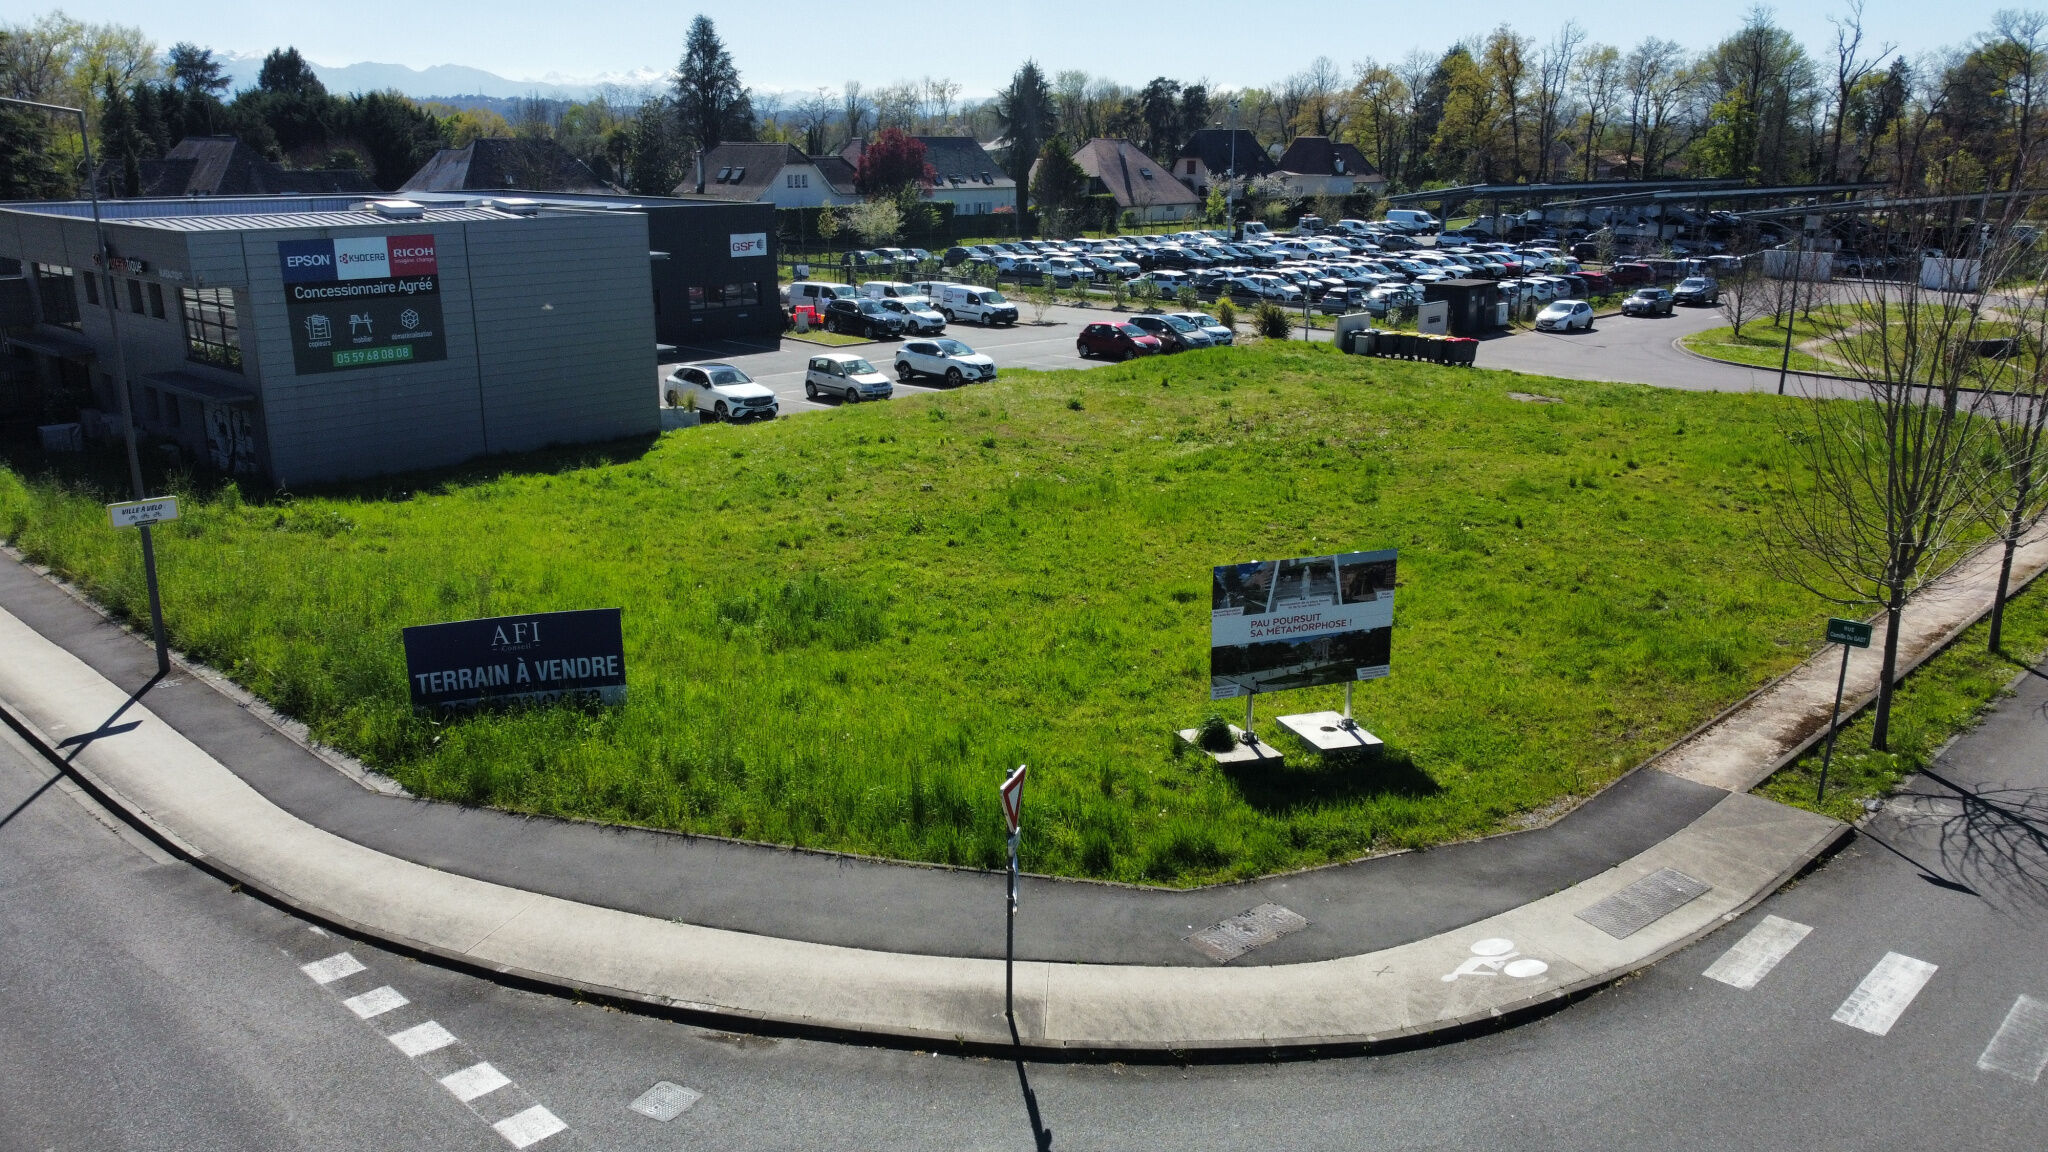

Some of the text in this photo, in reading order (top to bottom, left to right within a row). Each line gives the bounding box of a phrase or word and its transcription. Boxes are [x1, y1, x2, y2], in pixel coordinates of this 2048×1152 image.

[394, 248, 434, 257] RICOH
[732, 241, 755, 252] GSF
[287, 255, 331, 267] EPSON
[294, 277, 433, 300] Concessionnaire Agréé
[337, 348, 409, 364] 05 59 68 08 08
[1250, 613, 1321, 629] PAU POURSUIT
[1250, 629, 1263, 638] SA
[1266, 619, 1347, 636] MÉTAMORPHOSE
[491, 621, 542, 646] AFI
[415, 655, 619, 695] TERRAIN À VENDRE
